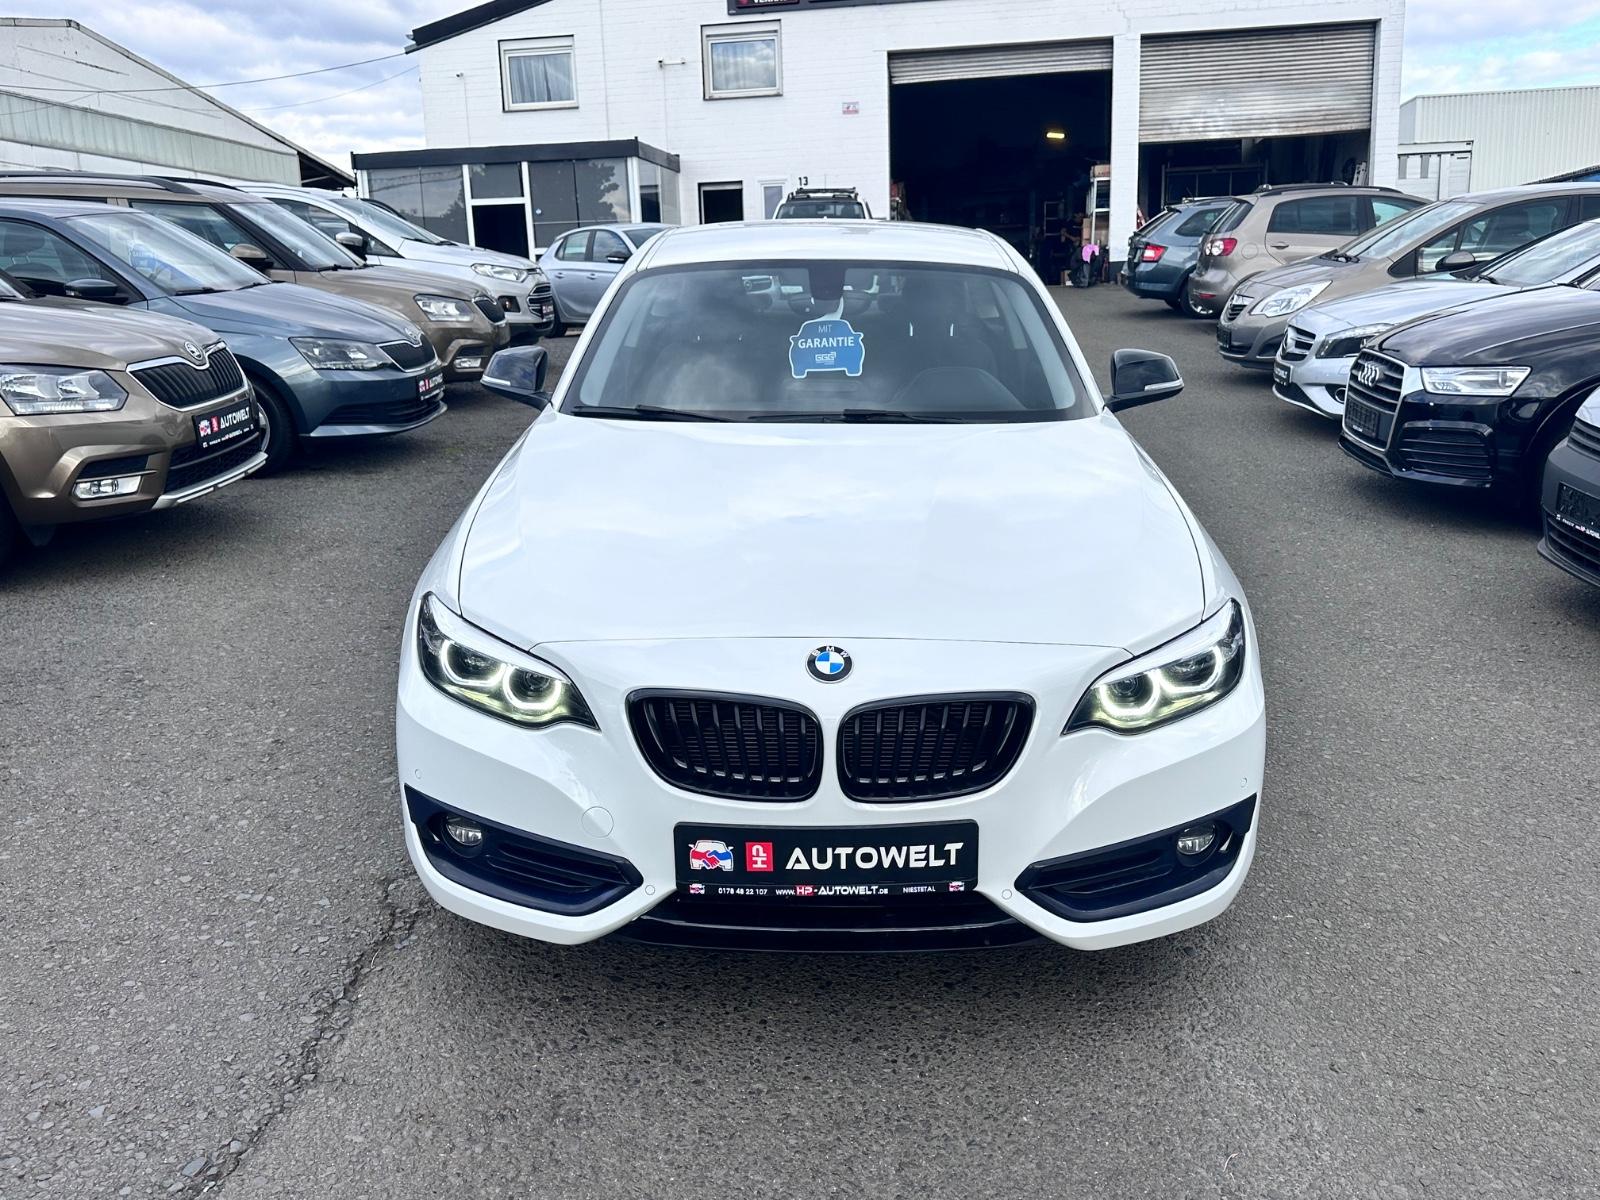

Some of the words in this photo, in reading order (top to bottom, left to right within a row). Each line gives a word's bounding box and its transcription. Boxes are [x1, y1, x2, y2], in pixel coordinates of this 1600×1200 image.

[798, 176, 809, 186] 13
[818, 324, 832, 333] MIT
[797, 336, 855, 349] GARANTIE
[811, 646, 850, 658] BMW
[785, 842, 964, 870] AUTOWELT
[718, 887, 734, 895] 0178
[902, 885, 936, 894] NIESTETAL
